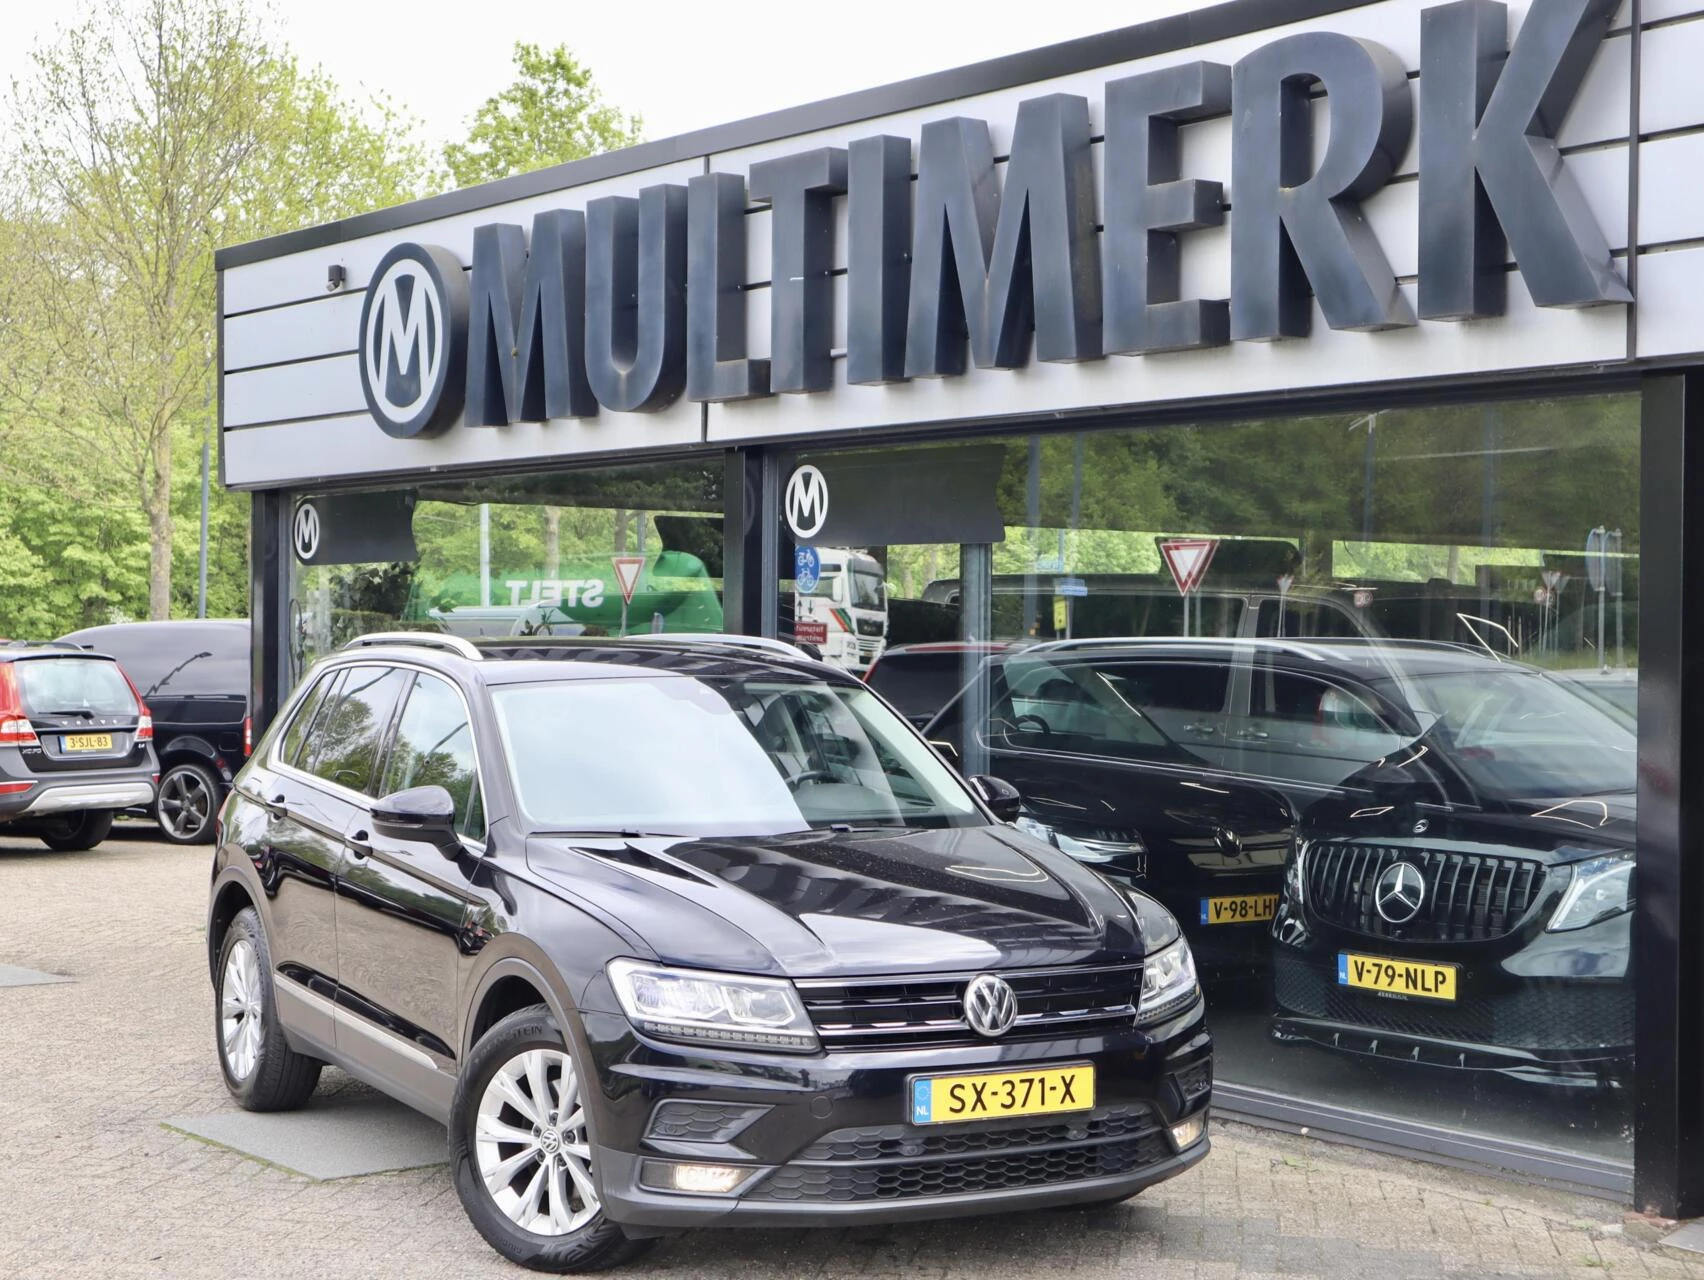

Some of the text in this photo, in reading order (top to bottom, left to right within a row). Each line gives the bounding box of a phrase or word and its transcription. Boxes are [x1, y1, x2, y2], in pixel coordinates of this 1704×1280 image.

[464, 0, 1634, 427] MULTIMERK
[374, 264, 435, 407] M
[789, 467, 825, 535] M
[297, 506, 317, 556] M
[70, 736, 109, 748] 3-SJL-83
[1353, 959, 1447, 993] V-79-NLP
[916, 1106, 928, 1117] NL
[949, 1074, 1076, 1113] SX-371-X
